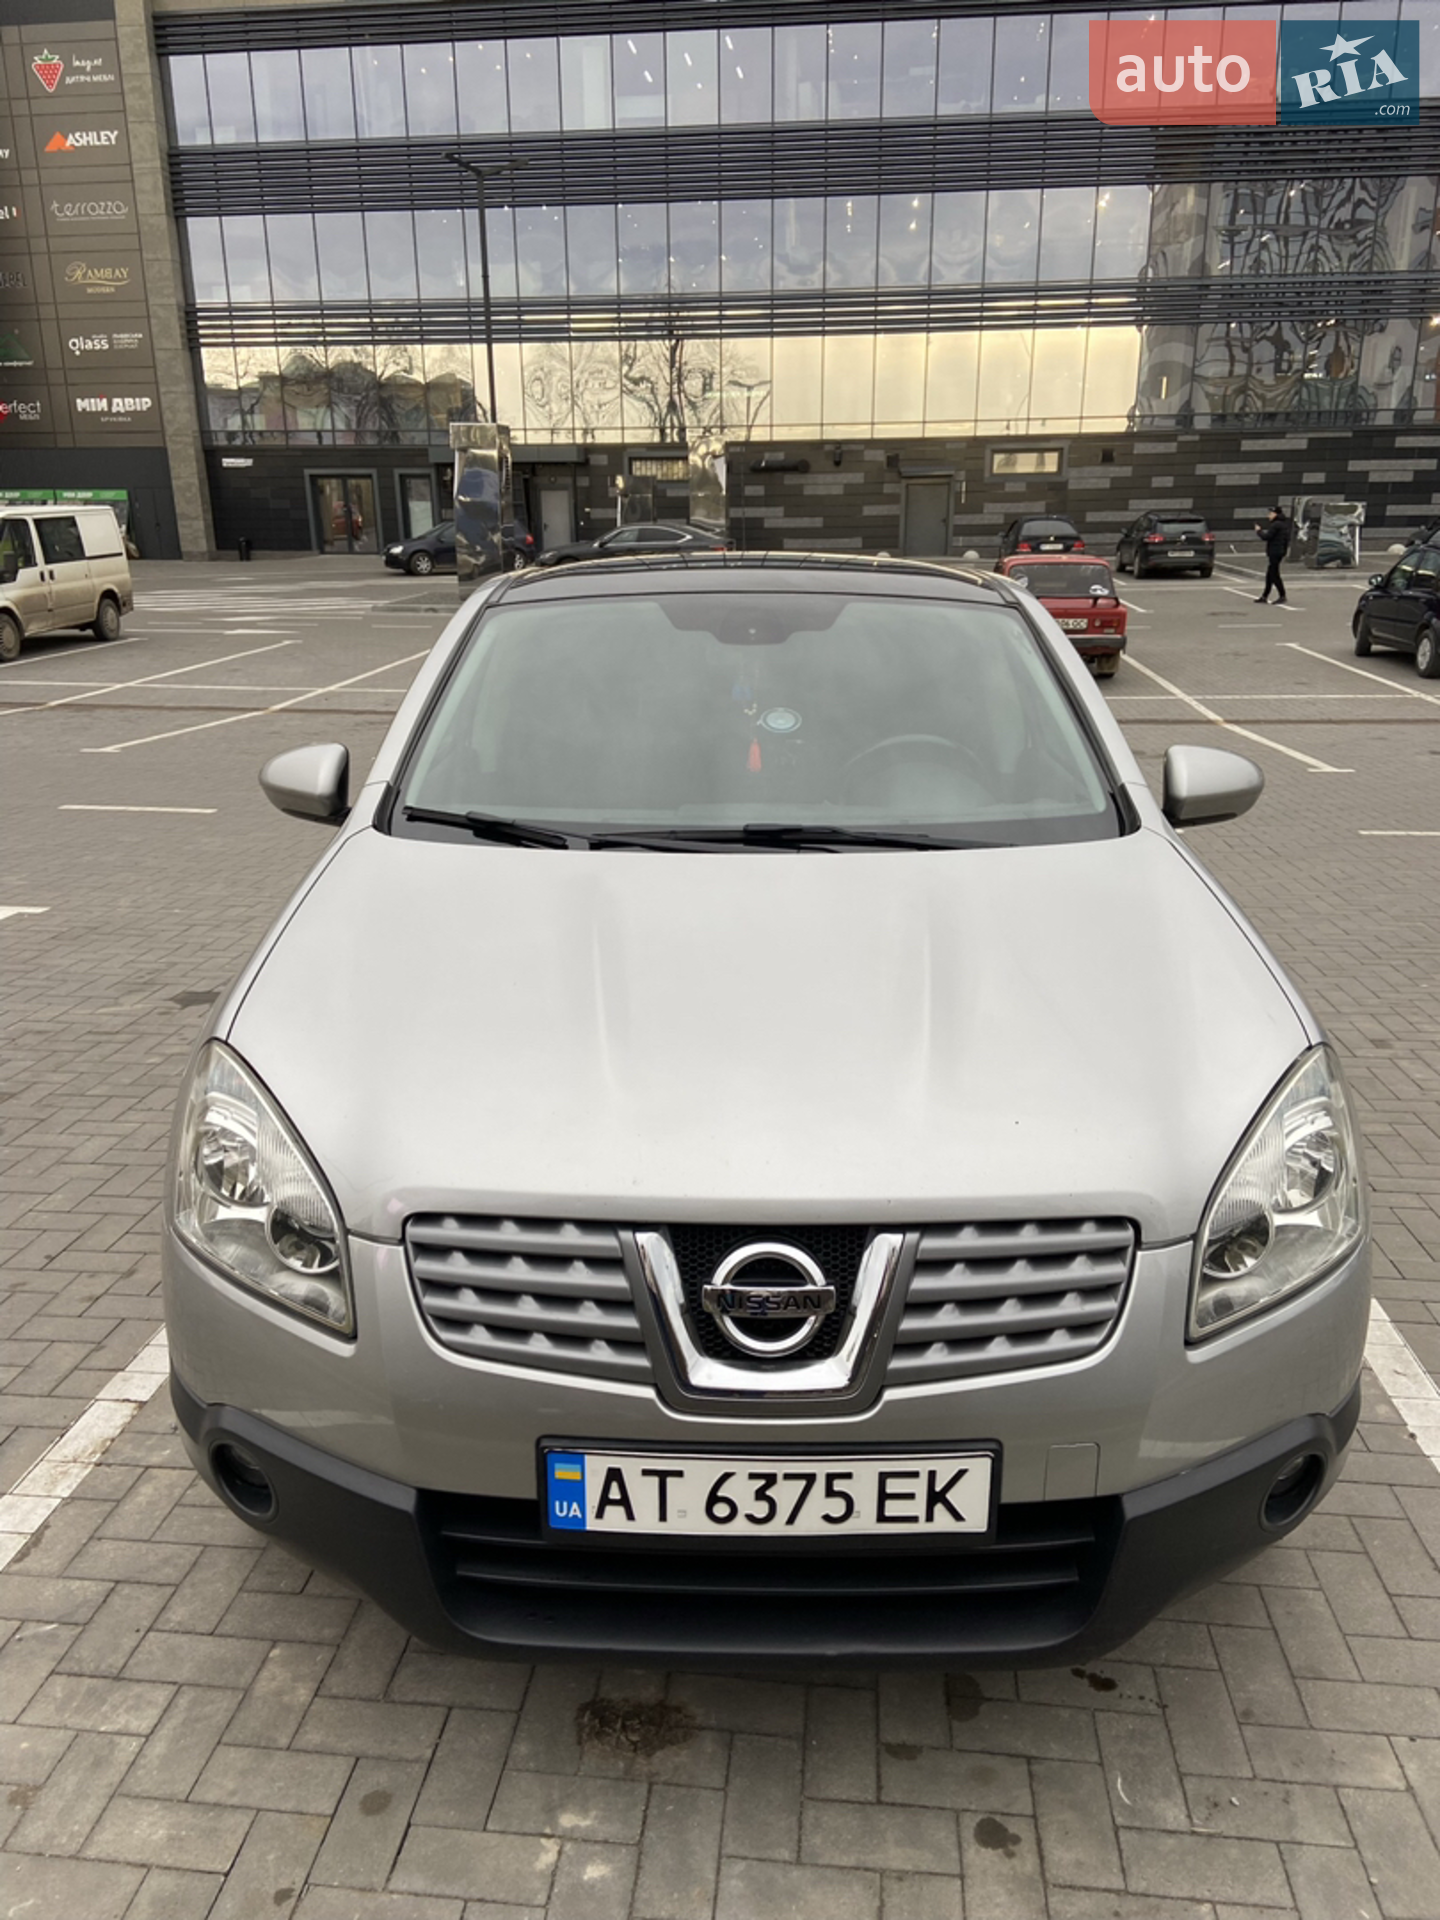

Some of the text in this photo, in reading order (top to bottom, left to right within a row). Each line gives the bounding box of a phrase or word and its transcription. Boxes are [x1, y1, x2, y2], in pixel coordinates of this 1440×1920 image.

[66, 130, 119, 147] ASHLEY
[68, 336, 110, 356] glass
[0, 400, 41, 414] erfect
[111, 397, 152, 413] ДВІР
[716, 1293, 822, 1312] NISSAN
[594, 1466, 970, 1526] AT 6375 EK
[554, 1500, 583, 1519] UA
